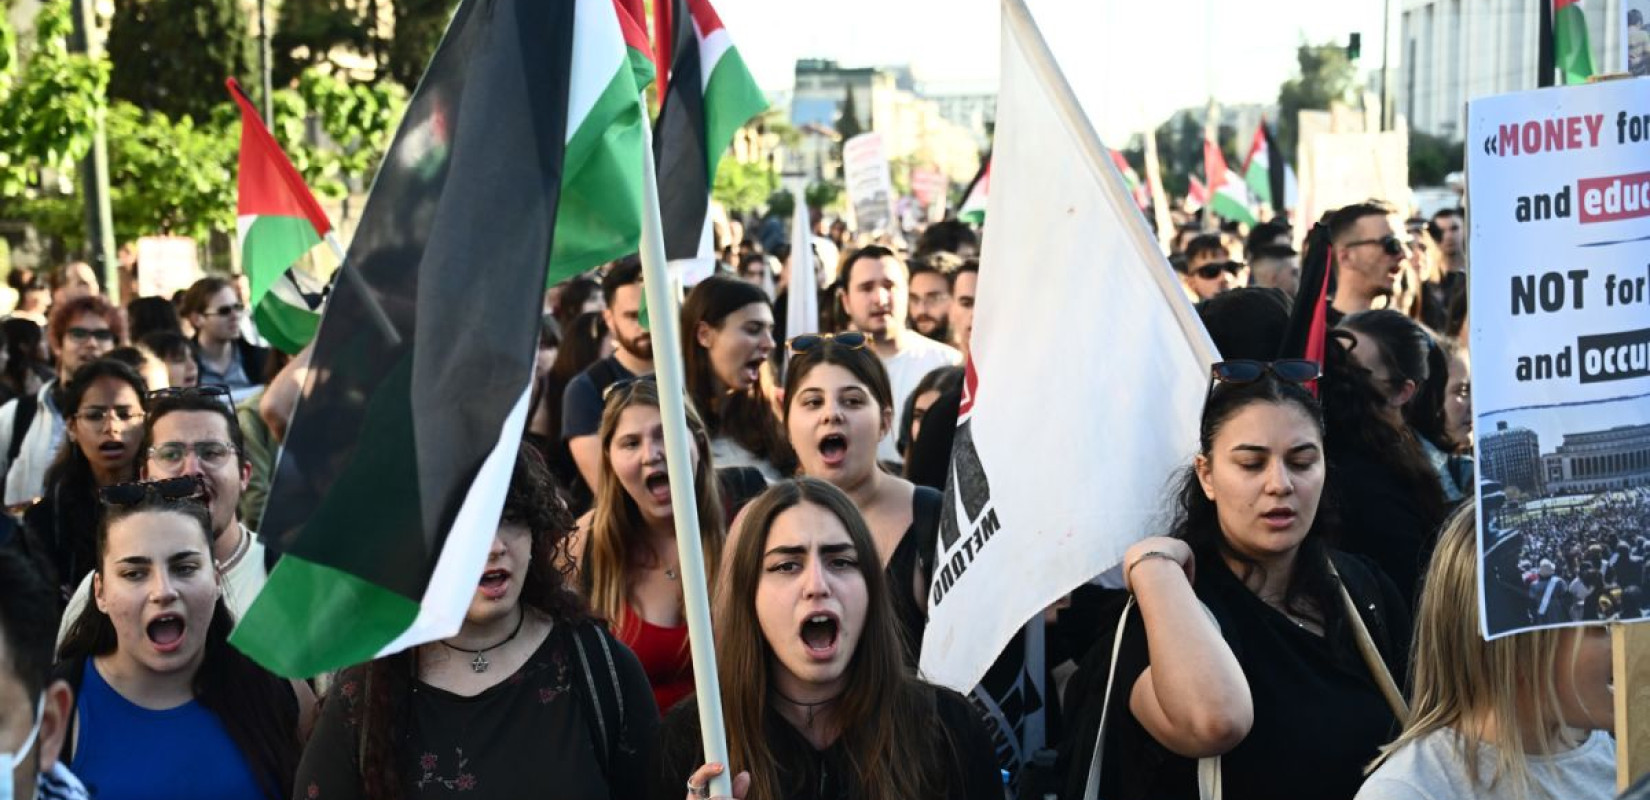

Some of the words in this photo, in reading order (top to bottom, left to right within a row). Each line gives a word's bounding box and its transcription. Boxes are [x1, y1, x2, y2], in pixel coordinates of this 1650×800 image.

[1484, 114, 1604, 156] «MONEY
[1616, 110, 1650, 145] for
[1515, 185, 1571, 223] and
[1511, 269, 1588, 316] NOT
[1605, 274, 1645, 306] for
[1516, 346, 1572, 381] and
[1584, 342, 1650, 376] occu
